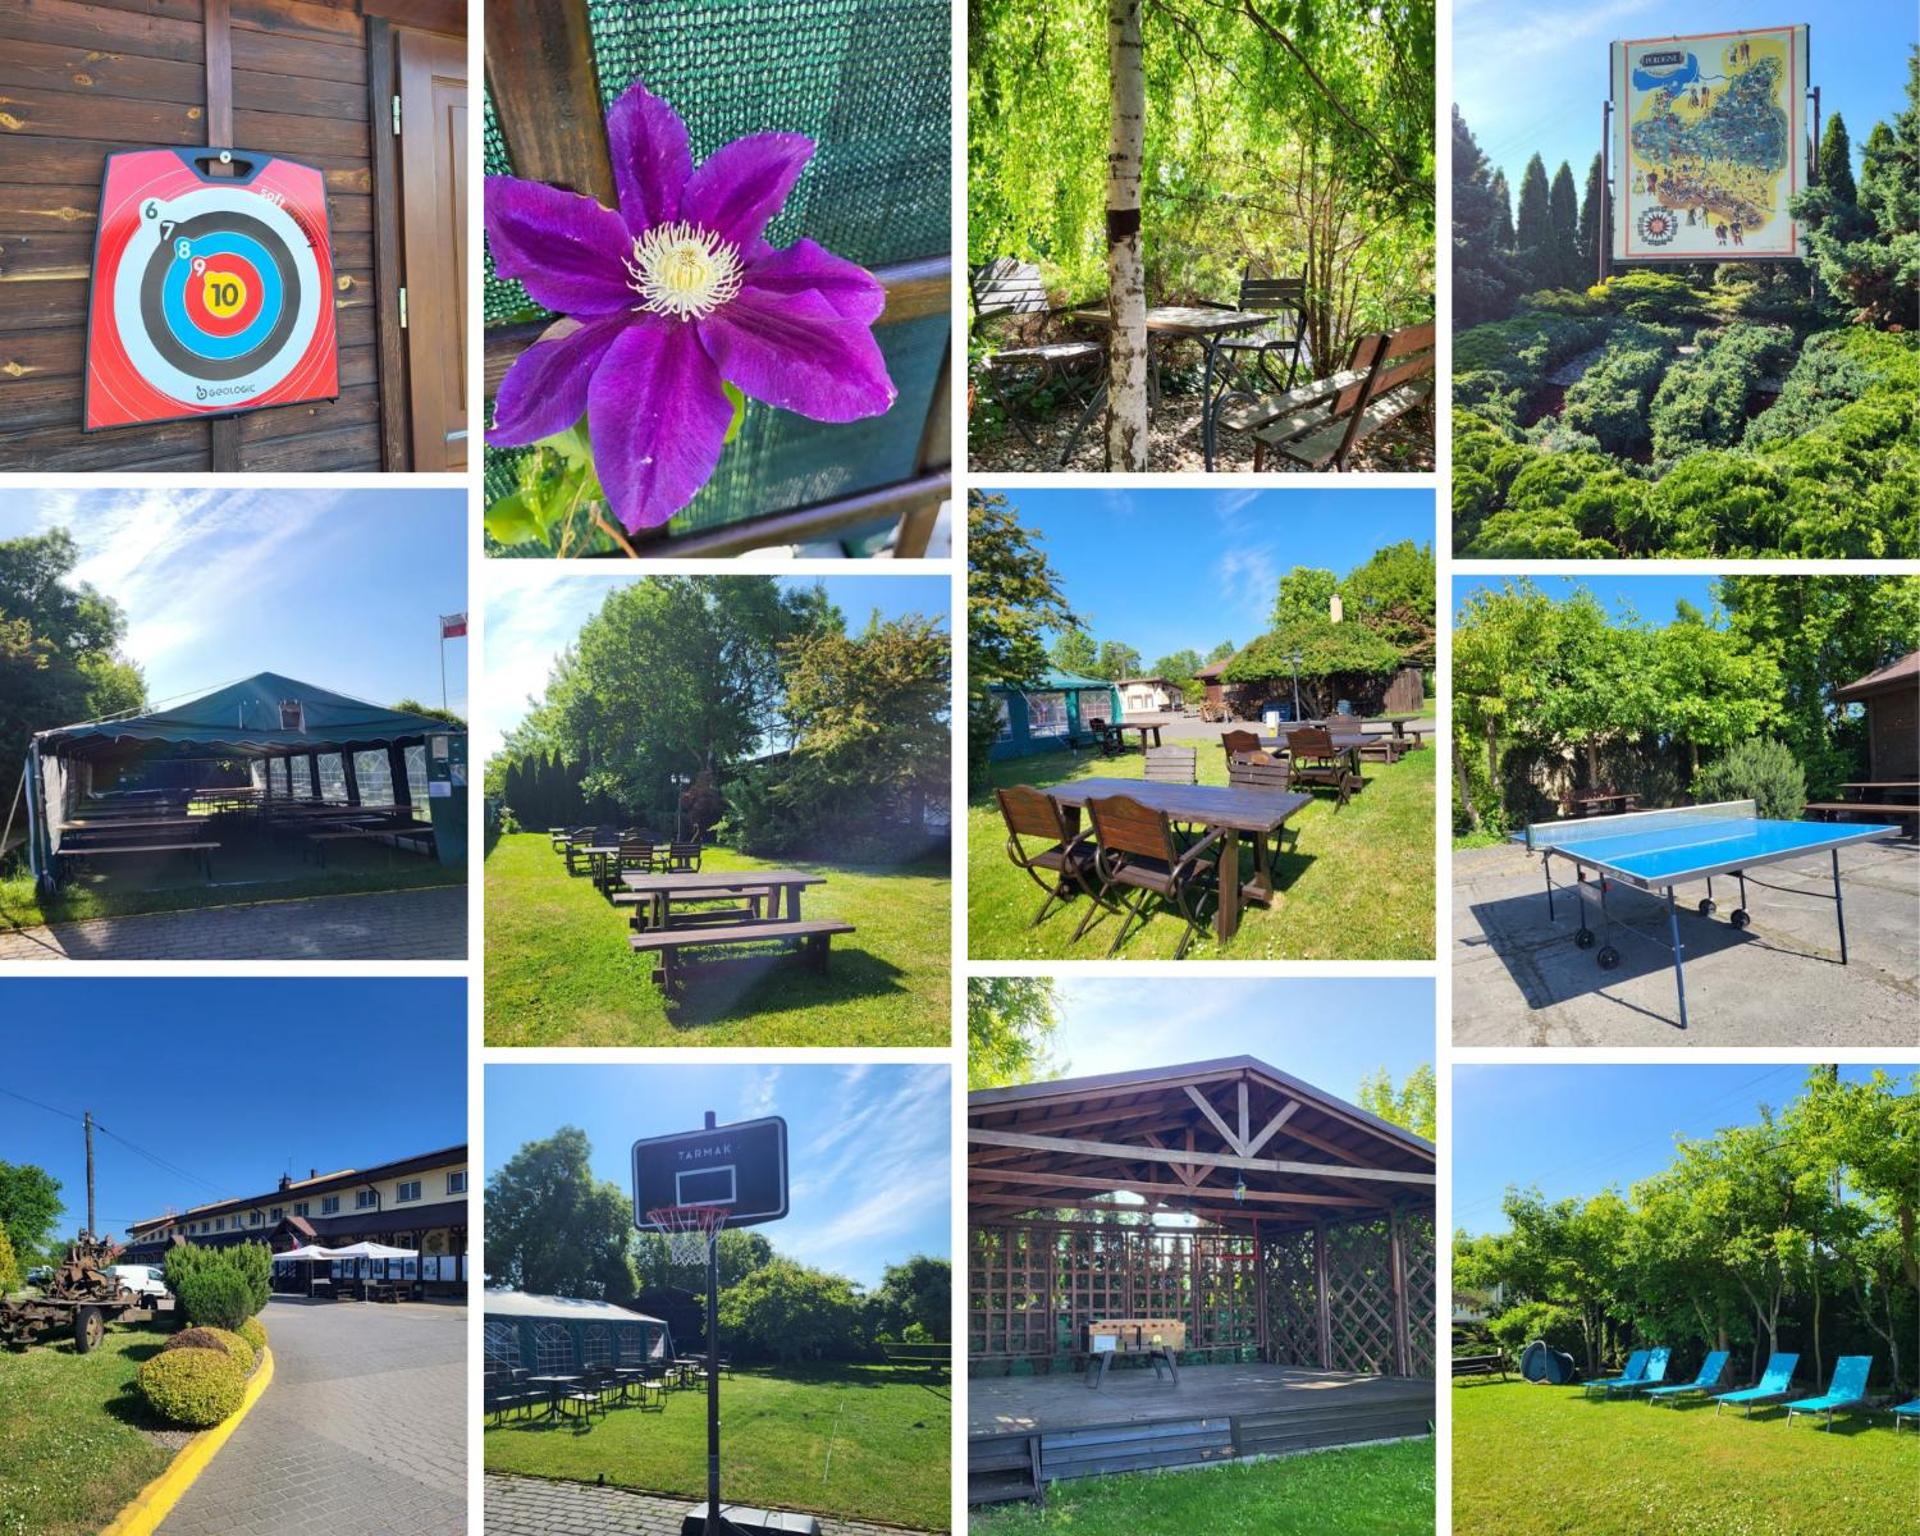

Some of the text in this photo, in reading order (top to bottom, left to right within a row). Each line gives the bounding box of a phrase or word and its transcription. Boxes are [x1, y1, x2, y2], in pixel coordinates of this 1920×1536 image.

[145, 201, 158, 219] 6
[162, 222, 175, 240] 7
[179, 240, 191, 259] 8
[194, 259, 206, 277] 9
[211, 283, 238, 307] 10
[678, 1143, 731, 1160] TARMAK
